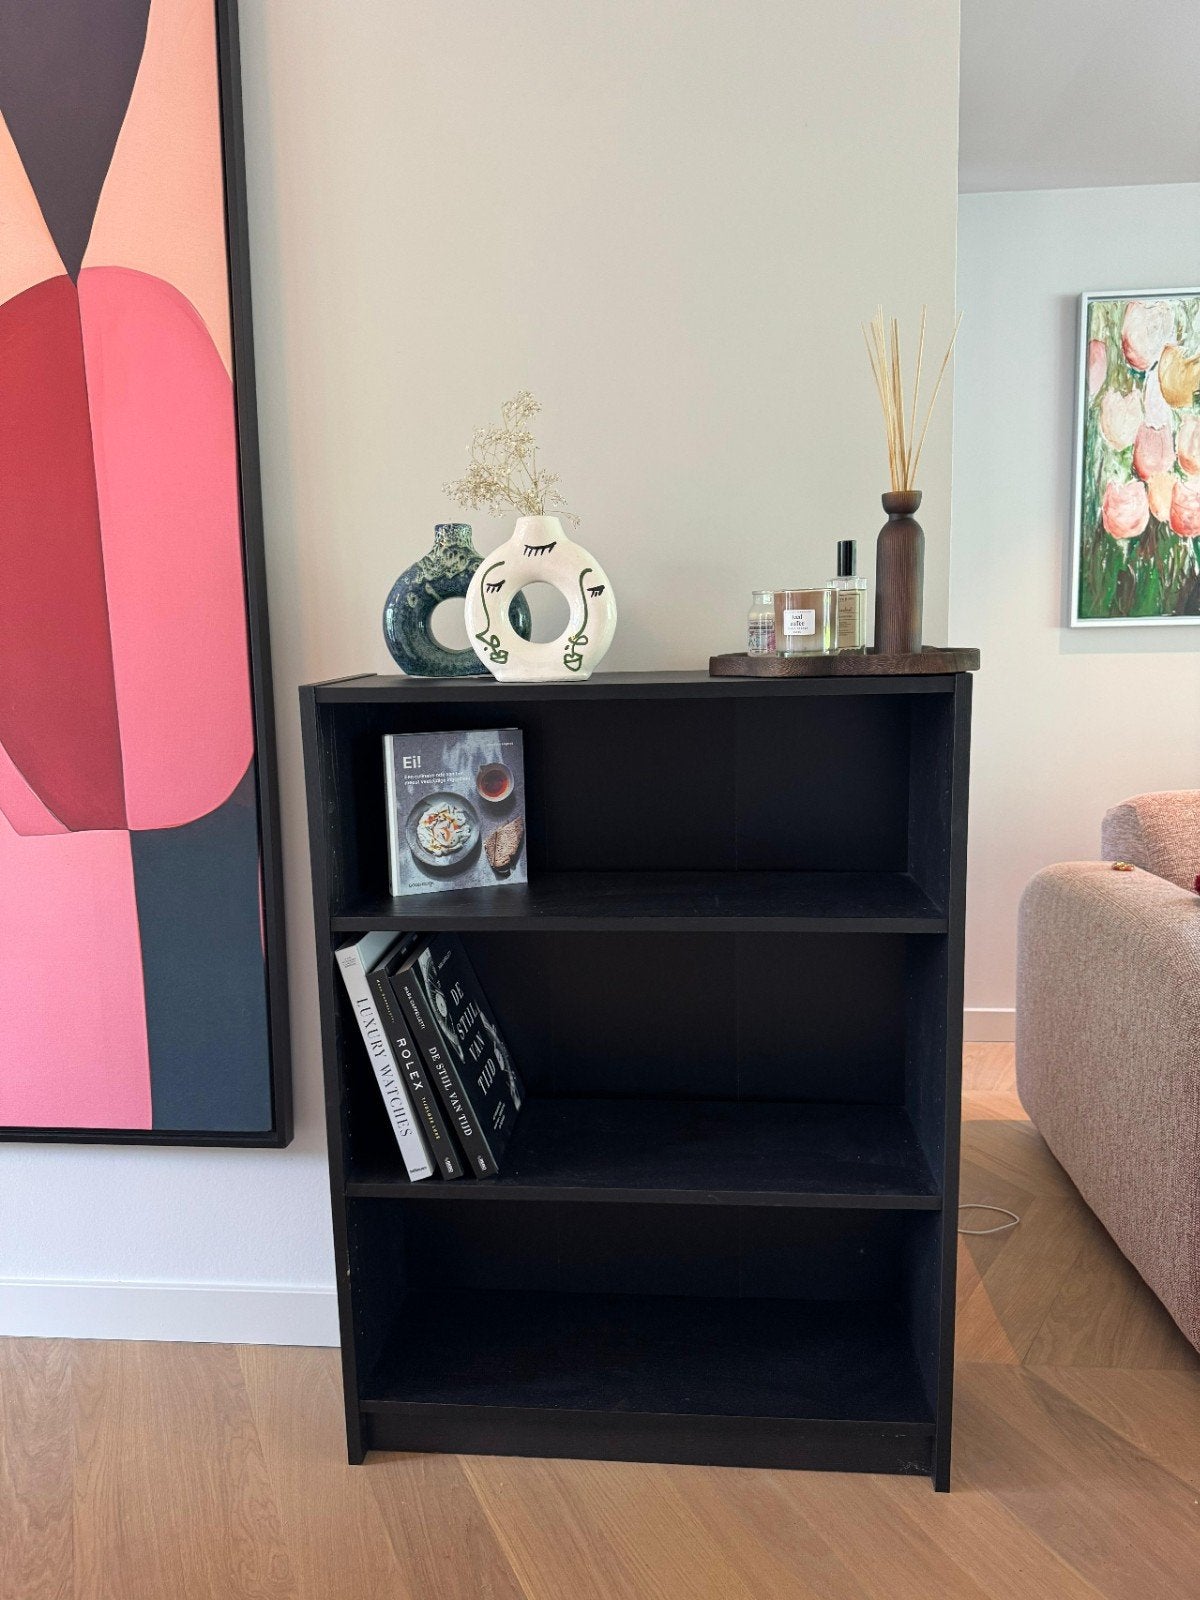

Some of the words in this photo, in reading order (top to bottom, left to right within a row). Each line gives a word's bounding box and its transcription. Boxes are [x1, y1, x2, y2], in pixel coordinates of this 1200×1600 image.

[402, 755, 421, 769] Ei!
[450, 981, 464, 1006] DE
[456, 1001, 479, 1041] STIJL
[396, 1037, 424, 1091] ROLEX
[468, 1030, 485, 1062] VAN
[356, 997, 387, 1058] LUXURY
[379, 1063, 413, 1137] WATCHES
[477, 1058, 496, 1096] TIJD
[428, 1046, 441, 1062] DE
[435, 1062, 453, 1091] STIJL
[448, 1091, 463, 1113] VAN
[458, 1113, 473, 1136] TIJD
